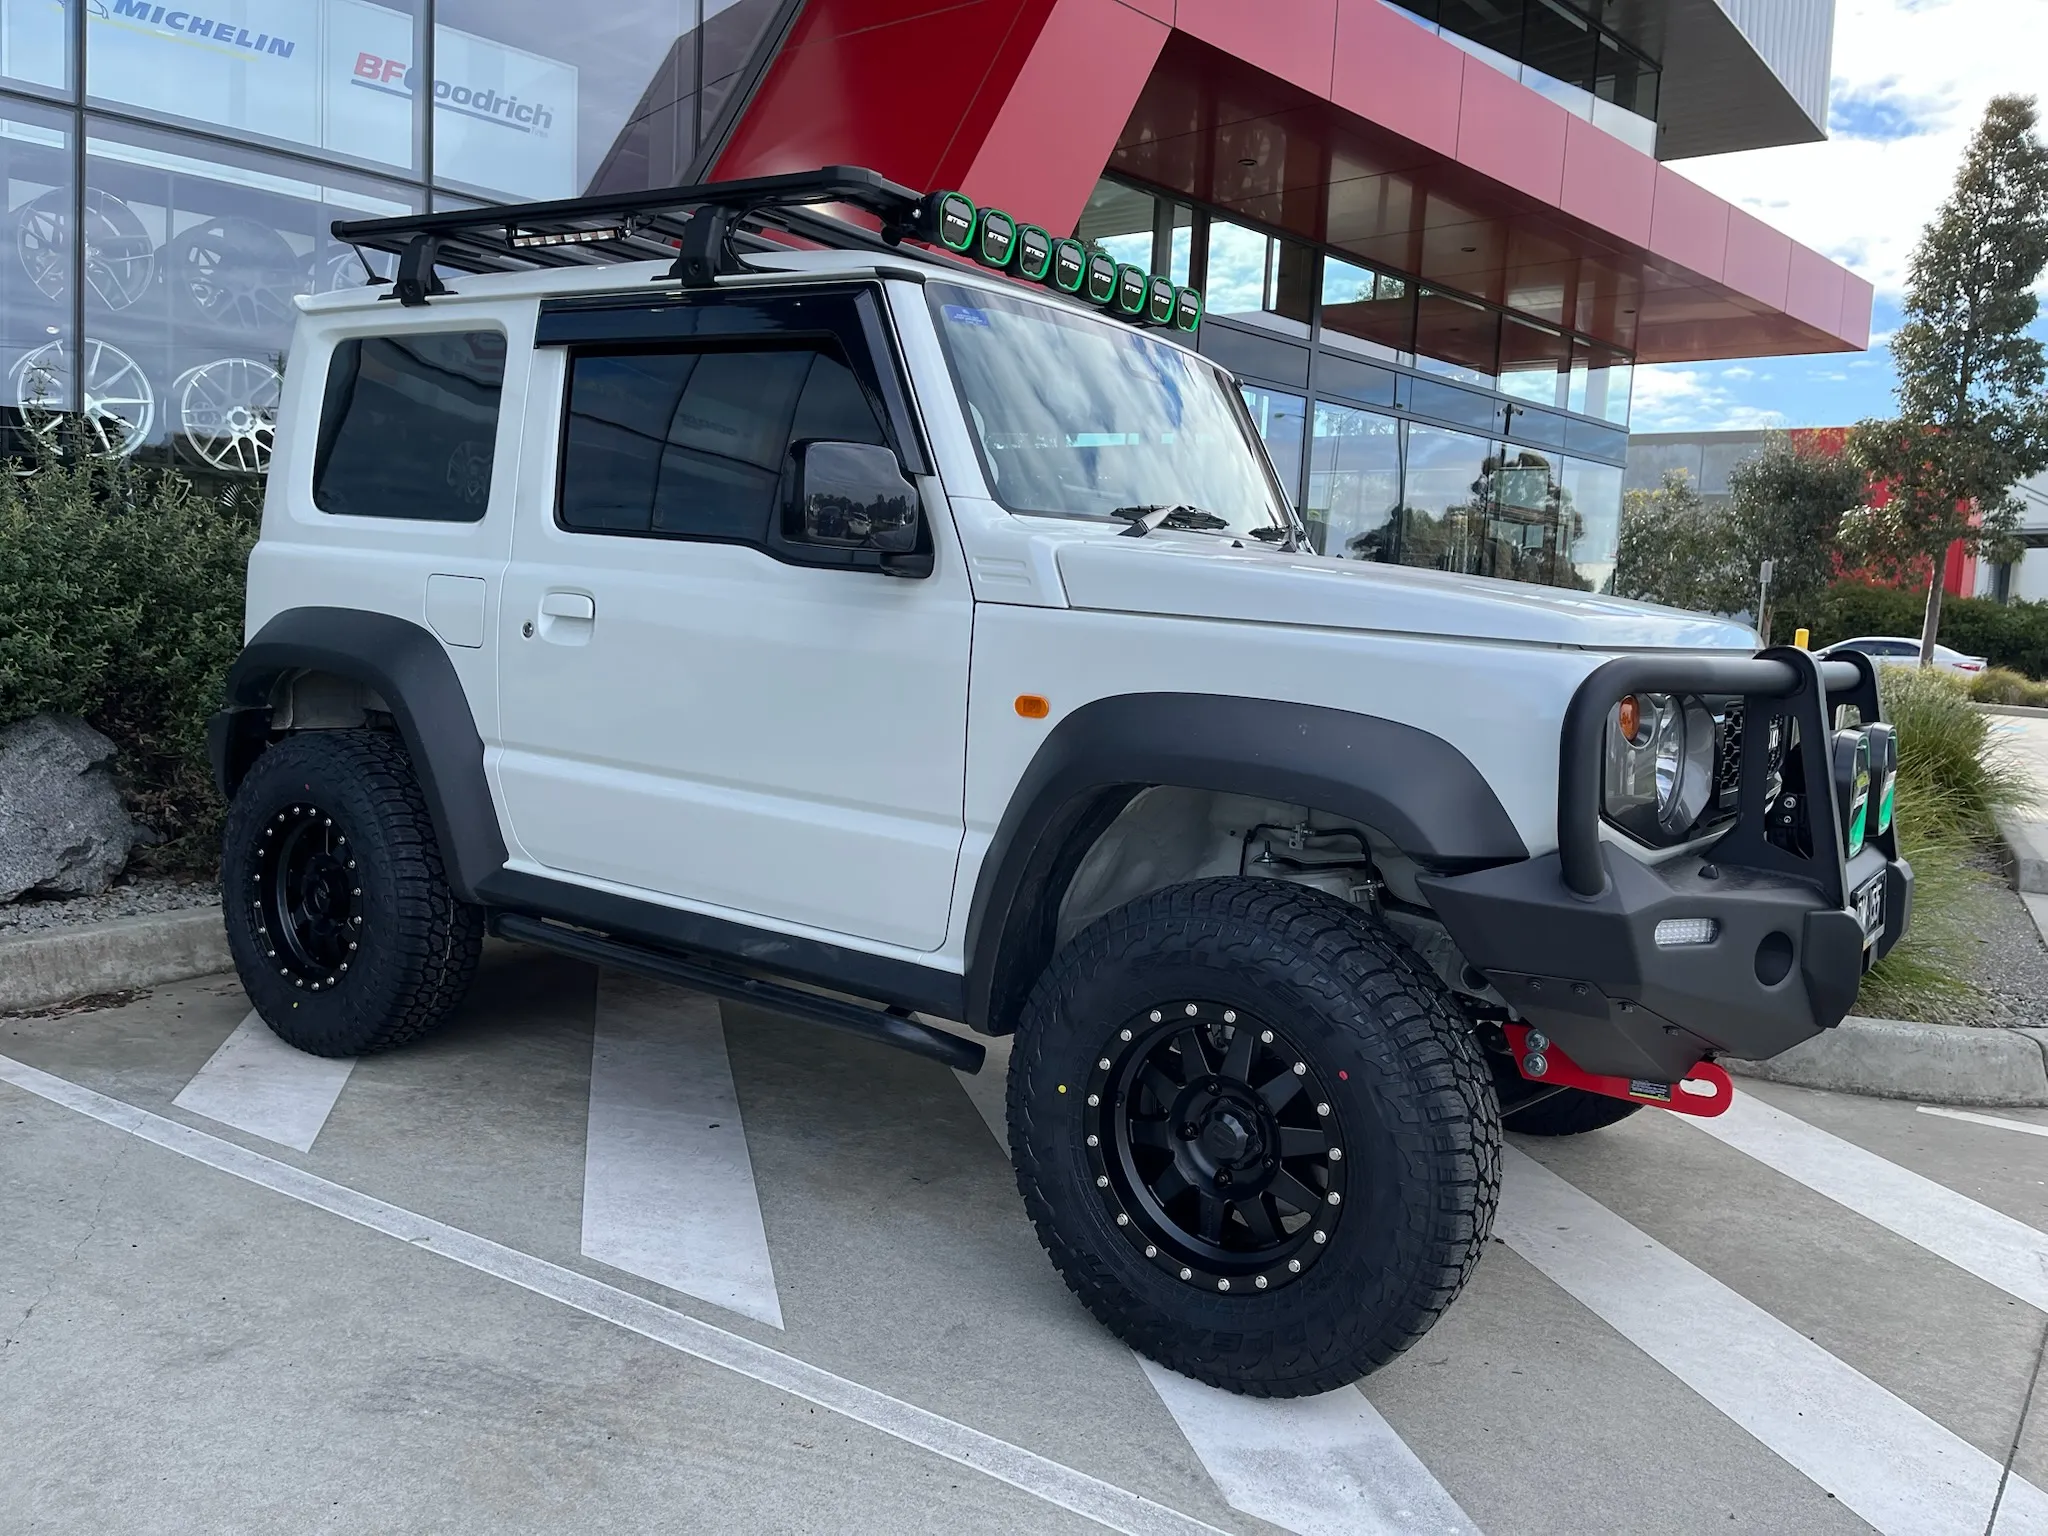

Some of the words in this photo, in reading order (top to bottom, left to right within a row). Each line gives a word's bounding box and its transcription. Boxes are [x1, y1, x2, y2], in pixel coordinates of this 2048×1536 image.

[112, 0, 296, 59] MICHELIN
[947, 214, 969, 229] STEDI
[987, 231, 1009, 244] STEDI
[1026, 246, 1045, 259] STEDI
